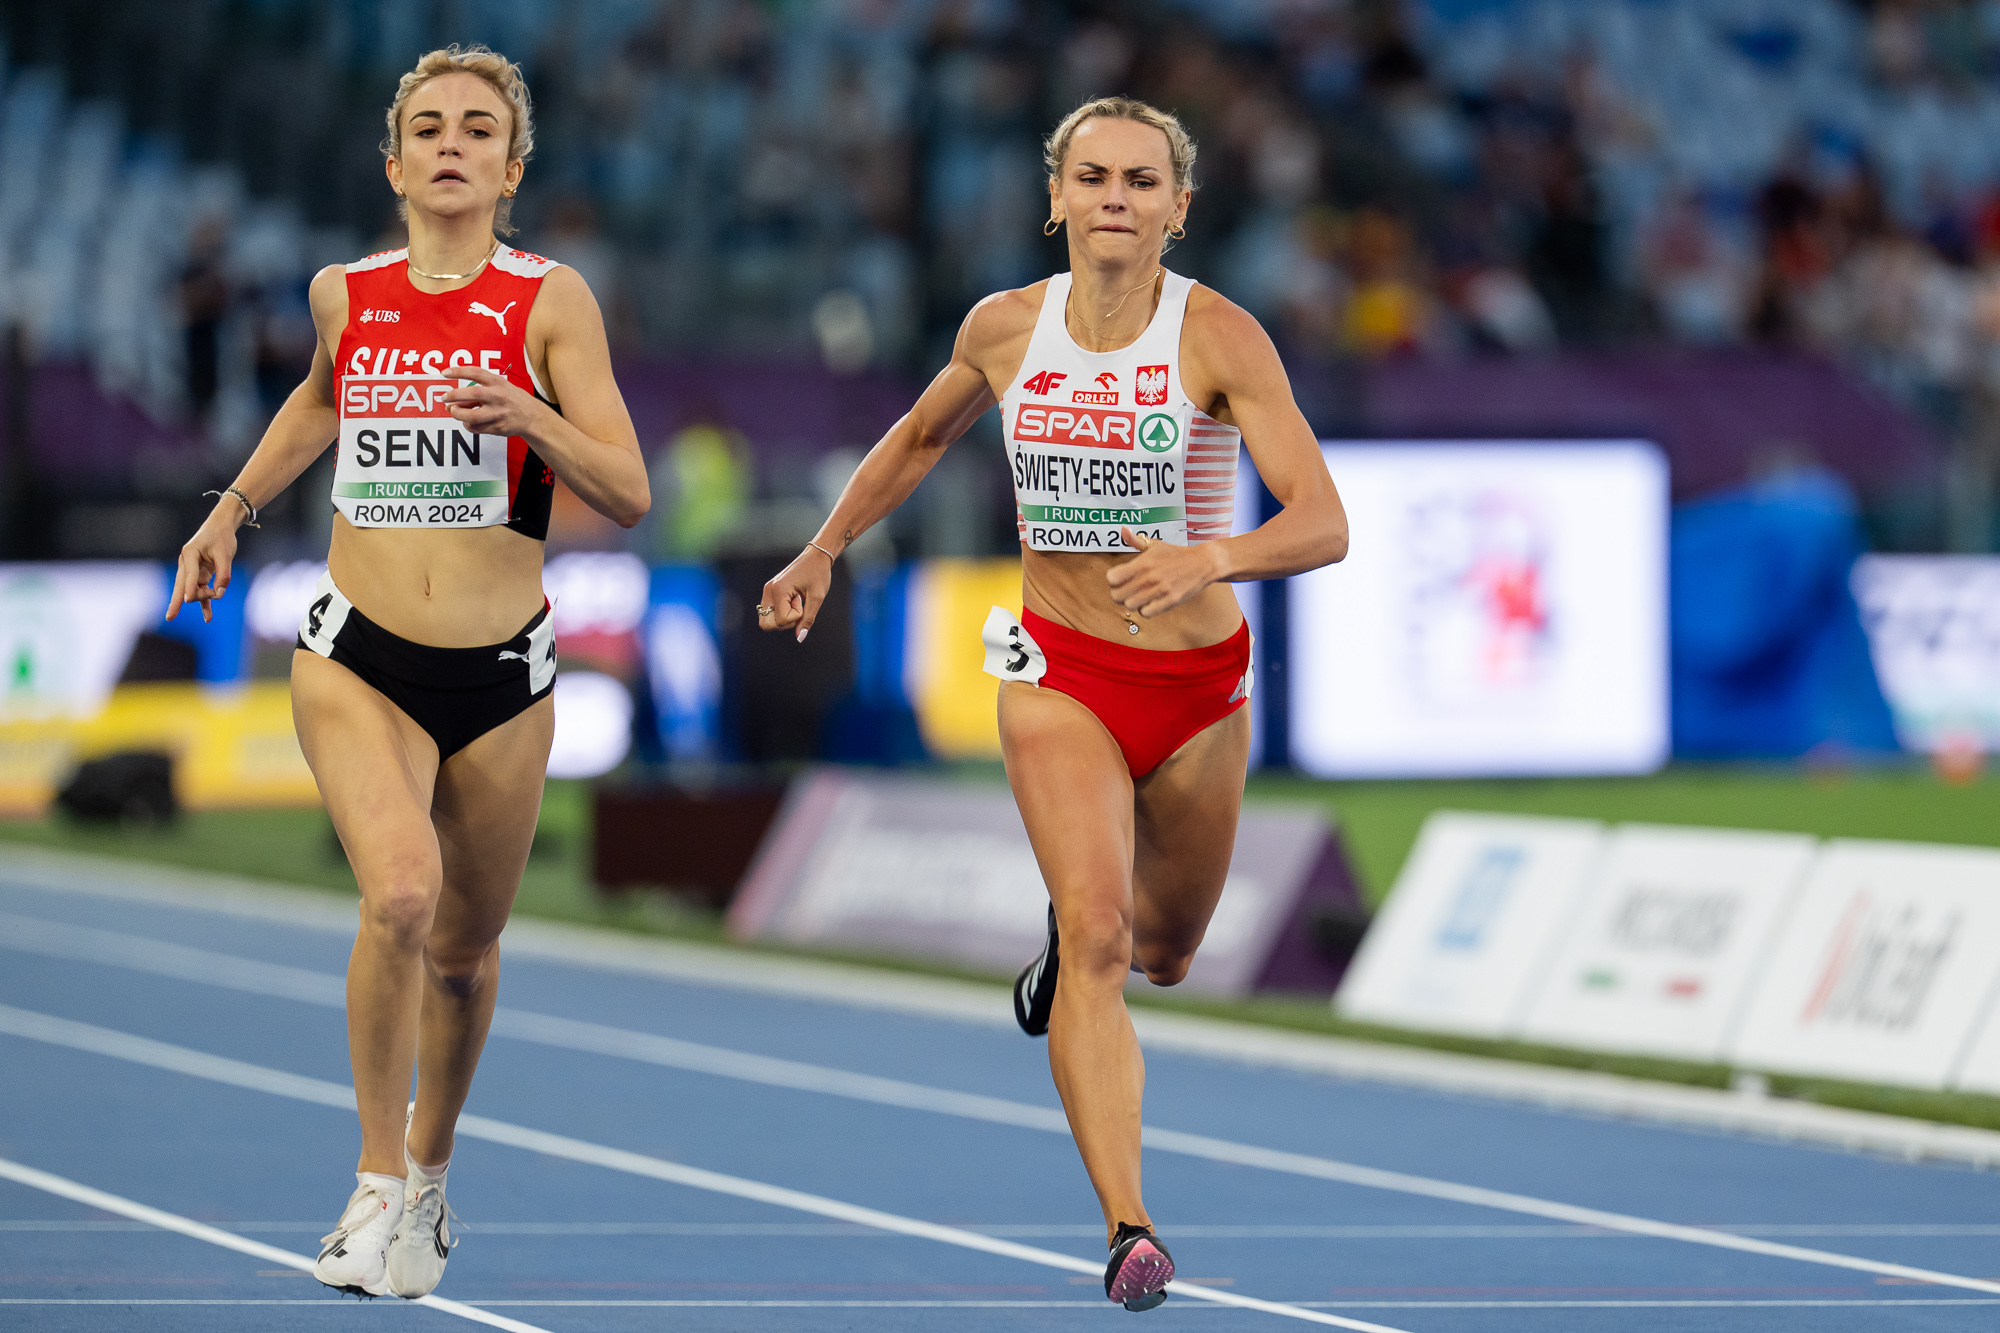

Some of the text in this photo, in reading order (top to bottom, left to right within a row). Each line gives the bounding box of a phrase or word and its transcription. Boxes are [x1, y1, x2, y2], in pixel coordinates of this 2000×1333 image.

[374, 310, 400, 323] UBS
[1023, 370, 1068, 395] 4F
[1074, 392, 1116, 404] ORLEN
[1018, 408, 1132, 445] SPAR
[356, 429, 481, 468] SENN
[1015, 444, 1176, 501] ŚWIĘTY-ERSETIC
[368, 484, 373, 497] I
[375, 484, 408, 497] RUN
[354, 504, 484, 523] ROMA 2024
[1044, 508, 1049, 520] I
[1052, 508, 1087, 521] RUN
[1033, 528, 1163, 547] ROMA 24
[309, 593, 334, 639] 4
[1004, 625, 1030, 673] 3
